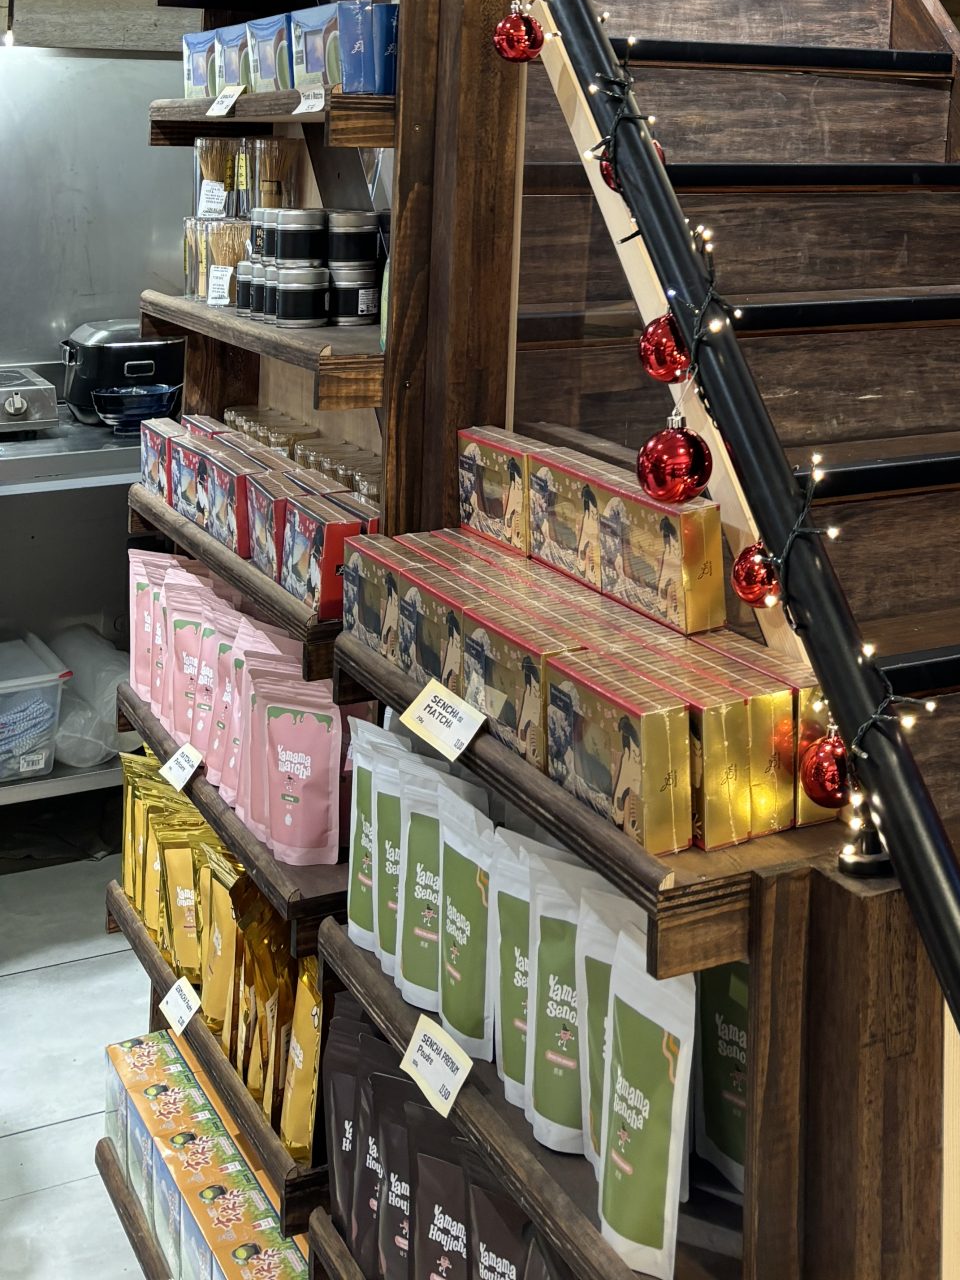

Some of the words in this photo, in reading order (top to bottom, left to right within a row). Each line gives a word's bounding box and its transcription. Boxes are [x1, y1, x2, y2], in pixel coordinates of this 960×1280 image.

[424, 704, 453, 730] MATCHA
[430, 695, 460, 720] SENCHA
[277, 744, 311, 767] Yamama
[446, 896, 470, 937] Yamama
[446, 919, 467, 945] Sencha
[416, 1044, 433, 1065] Poudre
[421, 1034, 442, 1058] SENCHA
[616, 1064, 650, 1120] Yamama
[613, 1093, 644, 1130] Sencha
[479, 1241, 516, 1280] Yamama
